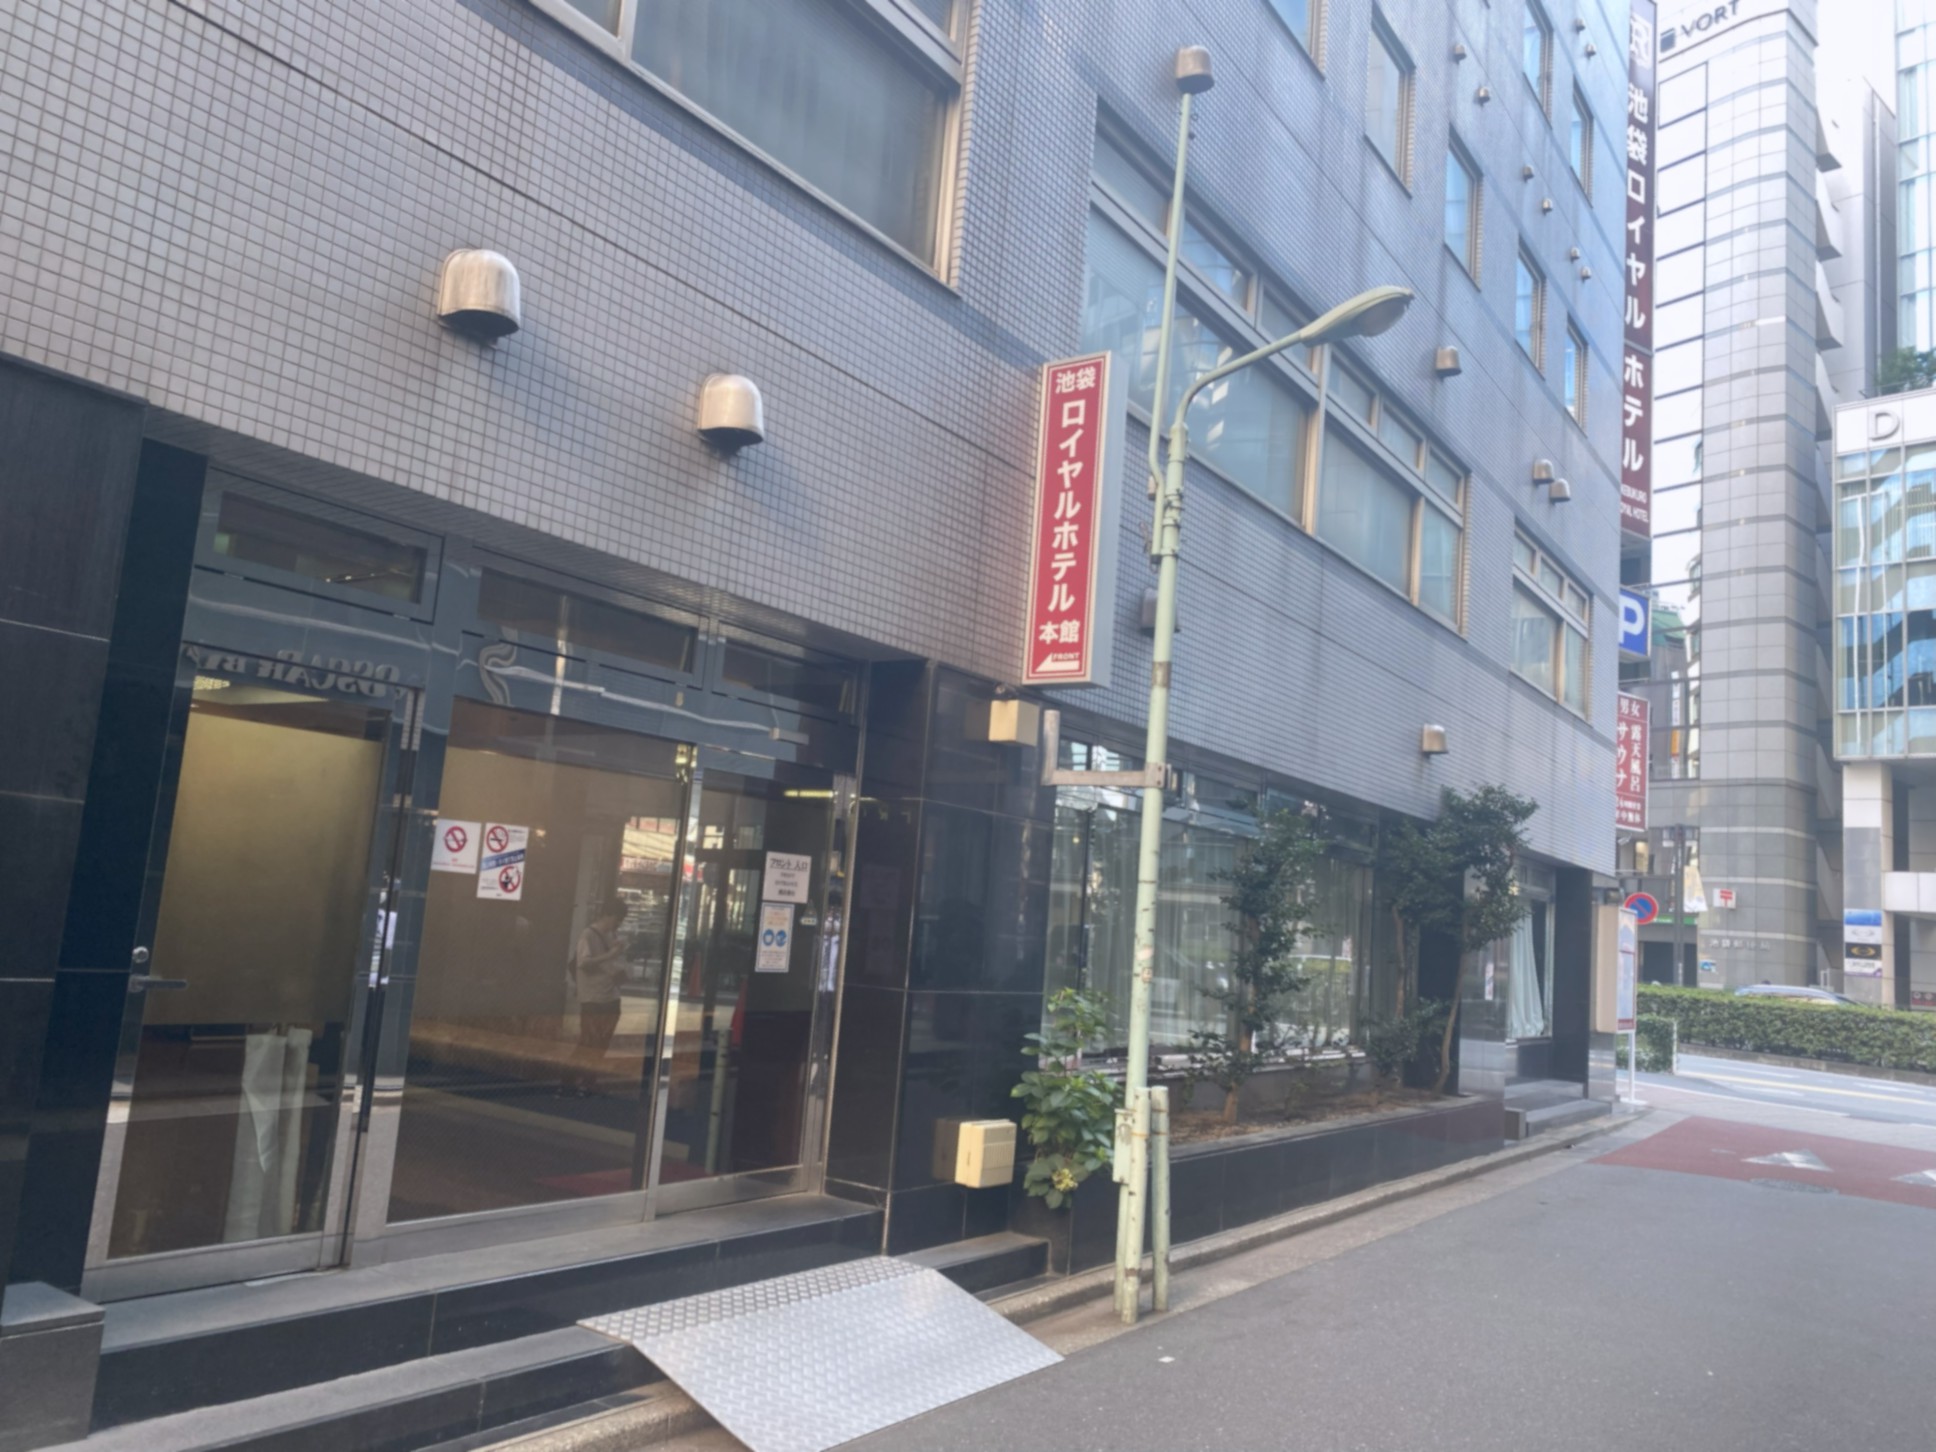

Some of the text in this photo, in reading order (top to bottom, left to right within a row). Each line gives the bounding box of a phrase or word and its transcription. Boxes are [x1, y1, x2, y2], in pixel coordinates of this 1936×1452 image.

[1681, 0, 1740, 38] VORT
[1056, 367, 1096, 394] 池袋
[1048, 399, 1087, 614] ロイヤルホテル
[1039, 620, 1081, 645] 本館
[1619, 597, 1646, 644] P
[1616, 722, 1629, 788] サウナ
[1630, 724, 1642, 792] 露天風呂
